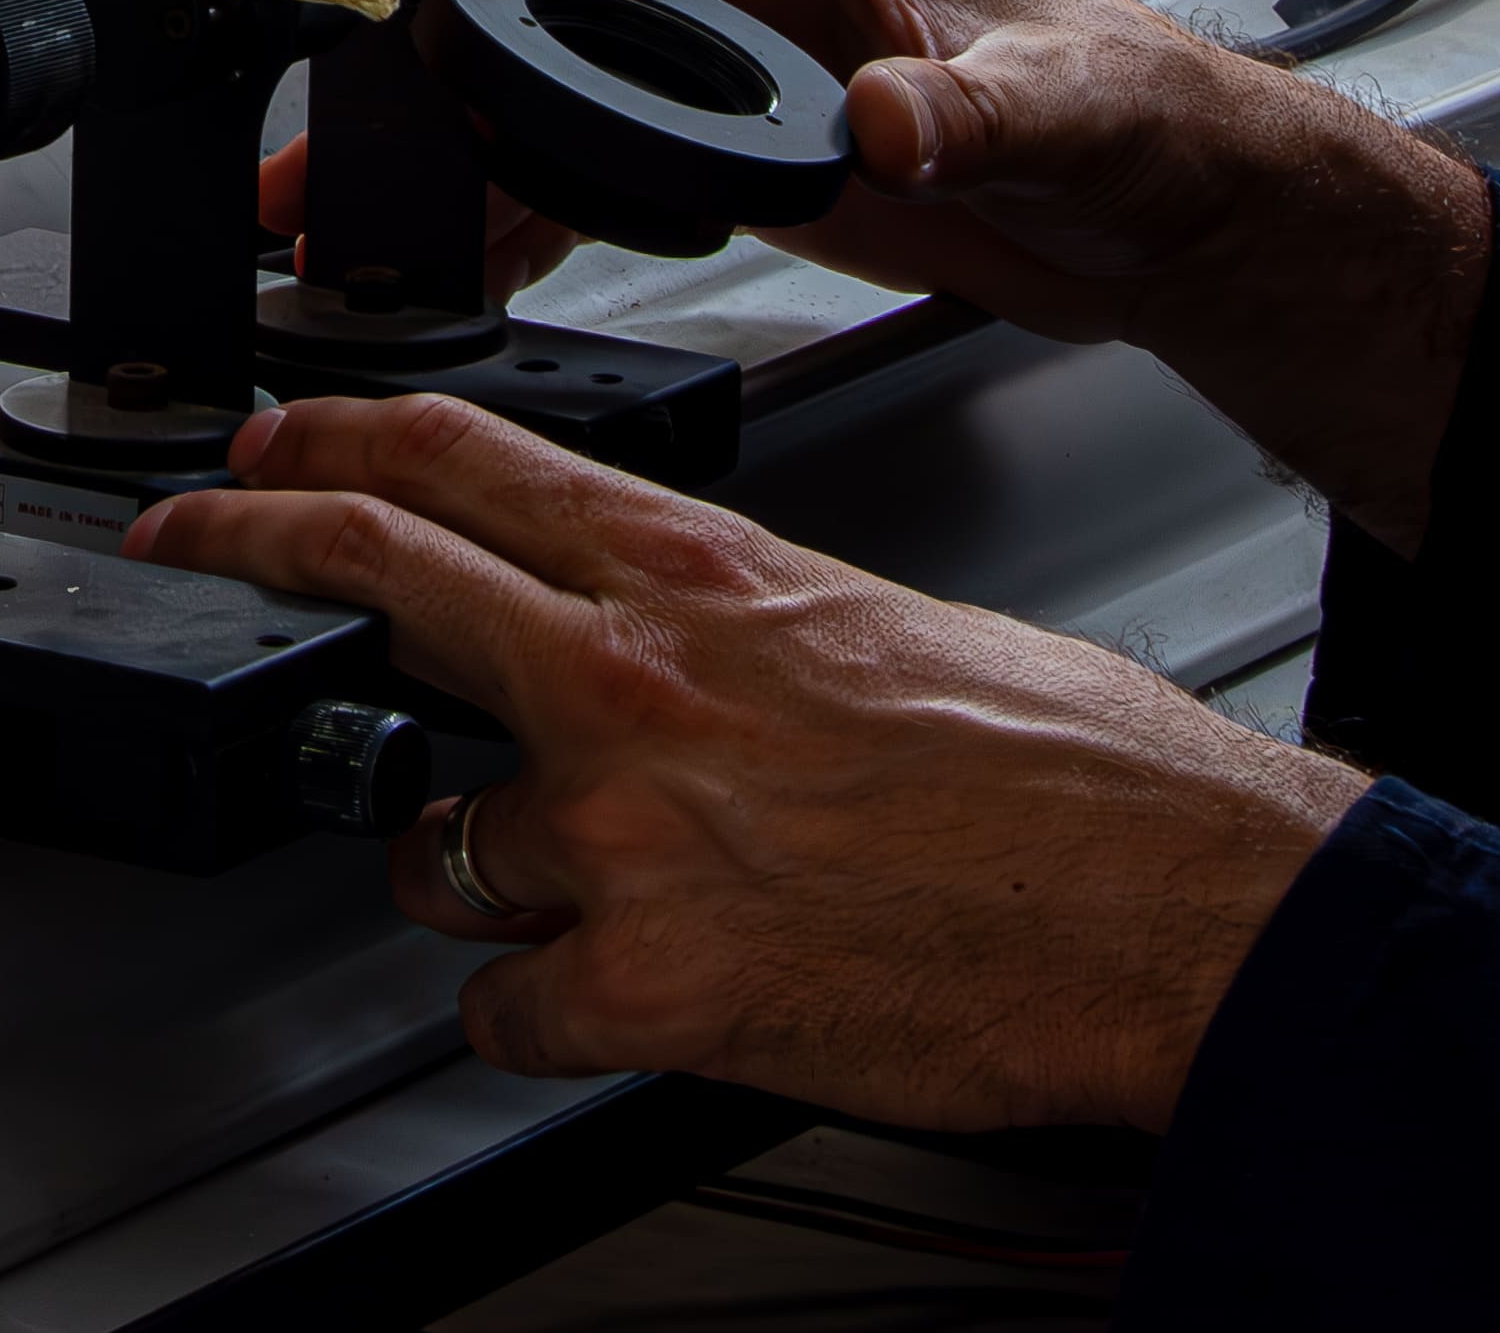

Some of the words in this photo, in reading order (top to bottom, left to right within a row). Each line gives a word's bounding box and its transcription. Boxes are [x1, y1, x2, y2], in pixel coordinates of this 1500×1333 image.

[18, 502, 53, 519] MADE
[59, 511, 73, 522] IN
[78, 513, 125, 532] FRANCE
